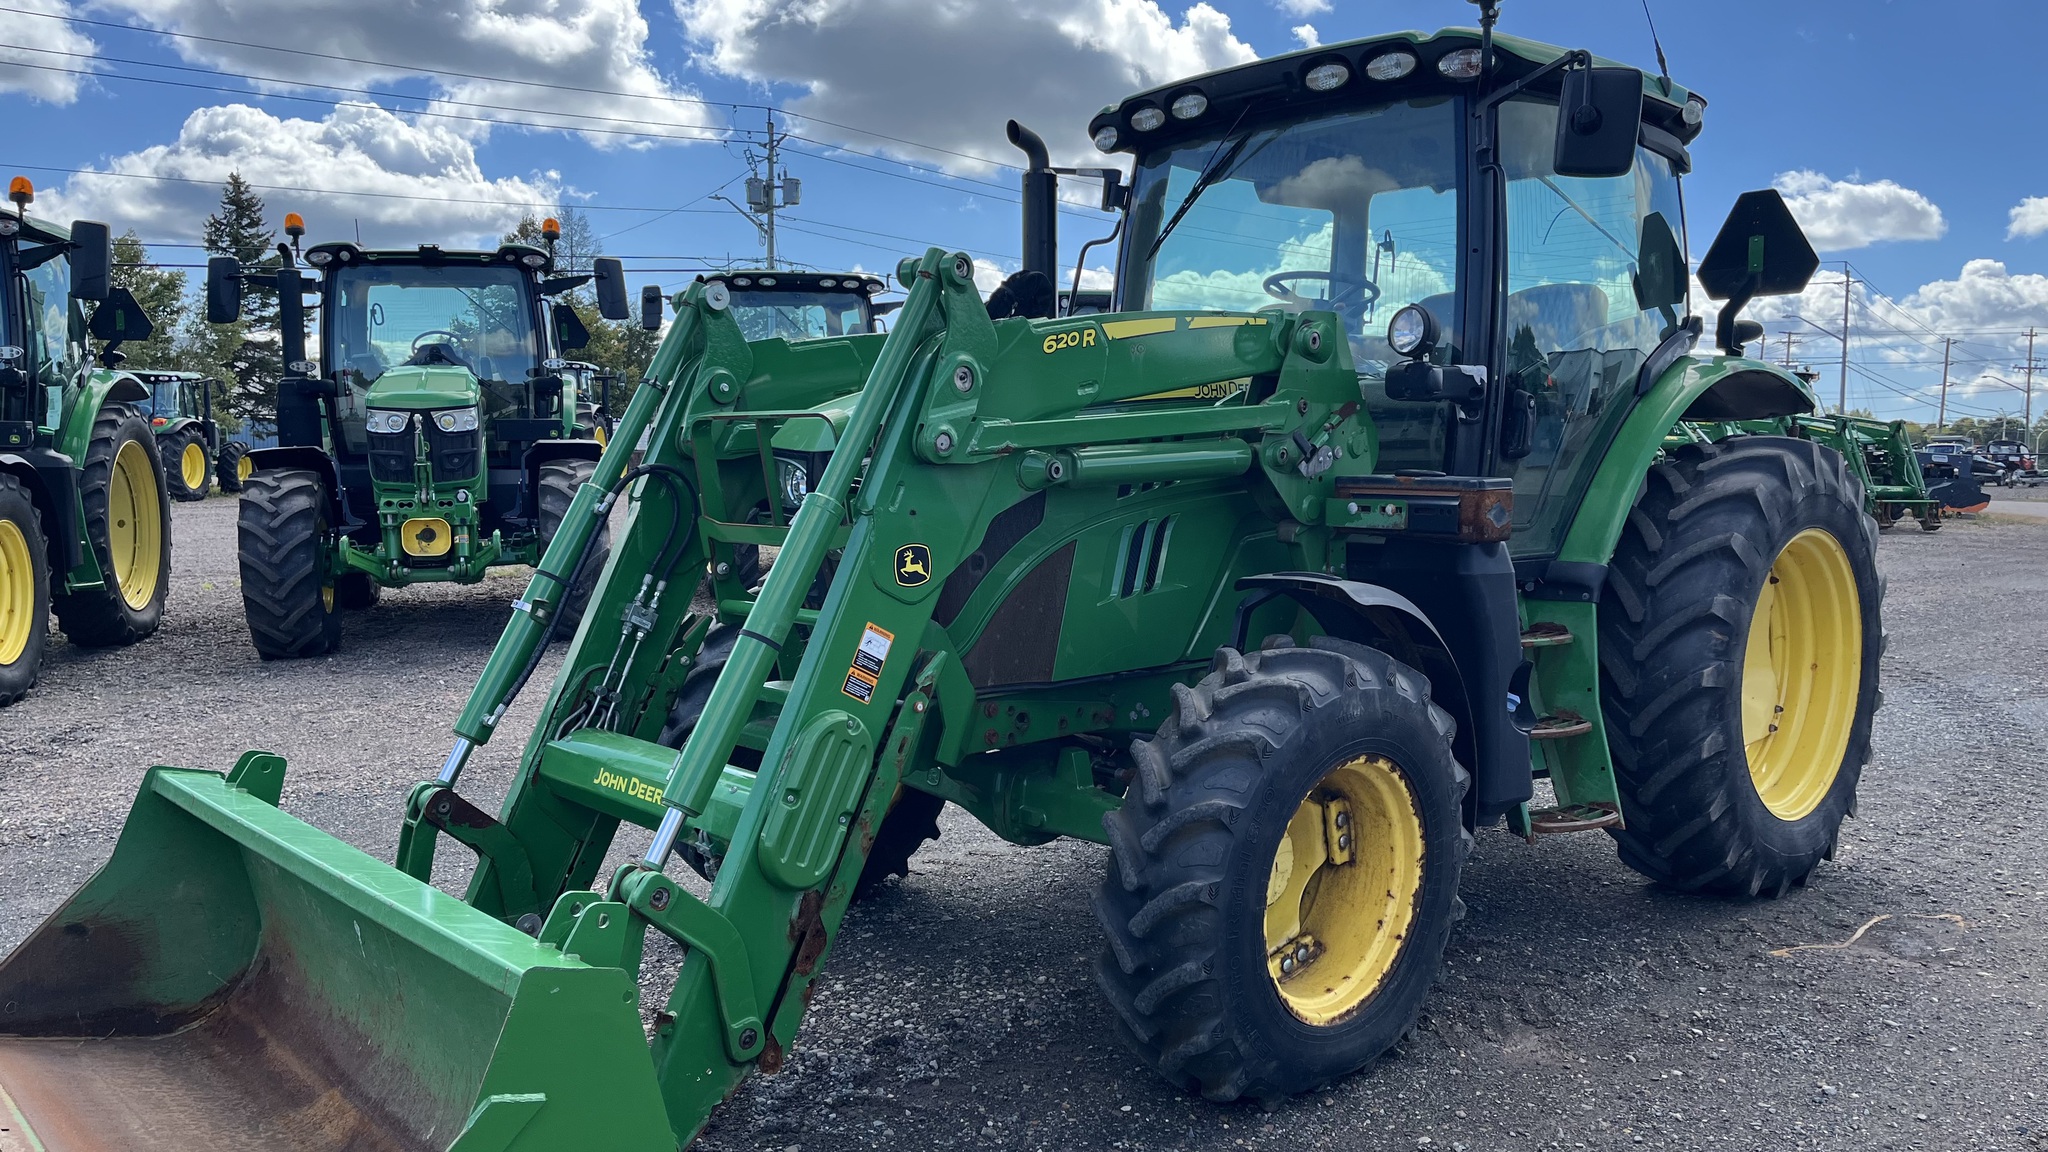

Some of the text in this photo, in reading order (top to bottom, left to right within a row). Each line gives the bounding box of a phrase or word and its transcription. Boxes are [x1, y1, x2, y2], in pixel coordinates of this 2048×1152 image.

[1042, 328, 1097, 354] 620 R
[1194, 383, 1227, 398] JOHN
[593, 767, 664, 806] JOHN DEER
